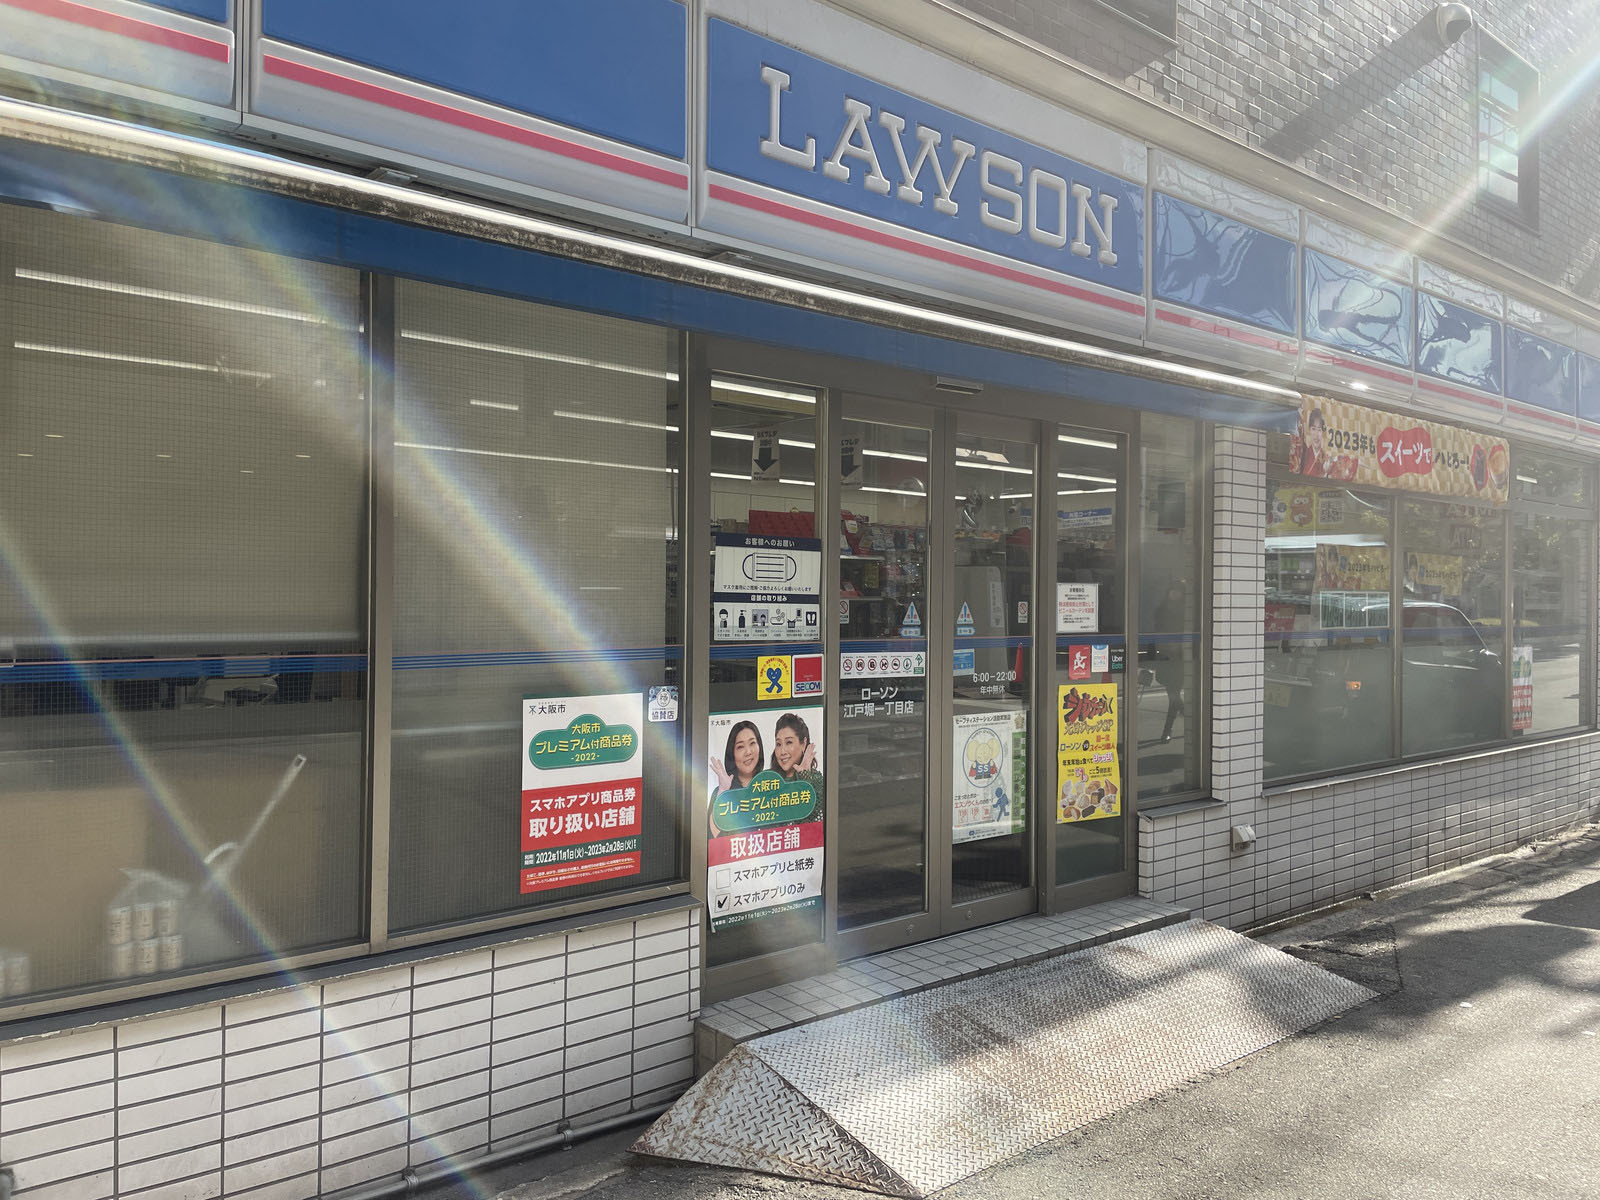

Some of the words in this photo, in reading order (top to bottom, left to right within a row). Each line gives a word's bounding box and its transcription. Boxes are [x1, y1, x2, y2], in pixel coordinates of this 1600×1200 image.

[760, 65, 1118, 266] LAWSON
[1328, 429, 1376, 454] 2023年も
[1380, 440, 1432, 466] スイーツで
[745, 537, 795, 547] お客様へのお願い
[796, 682, 821, 692] SECOM
[861, 686, 899, 701] ローソン
[980, 685, 1006, 695] 年中無休
[538, 704, 567, 715] 大阪市
[843, 701, 915, 717] 江戸堀一丁目店
[572, 723, 601, 734] 大阪市
[536, 734, 633, 755] プレミアム付商品券
[1060, 742, 1081, 752] ローソン
[752, 779, 780, 792] 大阪市
[530, 787, 636, 813] スマホアプリ商品券
[719, 790, 811, 816] プレミアム付商品券
[529, 806, 636, 839] 取り扱い店舗
[730, 827, 801, 859] 取扱店舗
[734, 857, 815, 883] スマホアプリと紙券
[734, 883, 806, 907] スマホアプリのみ
